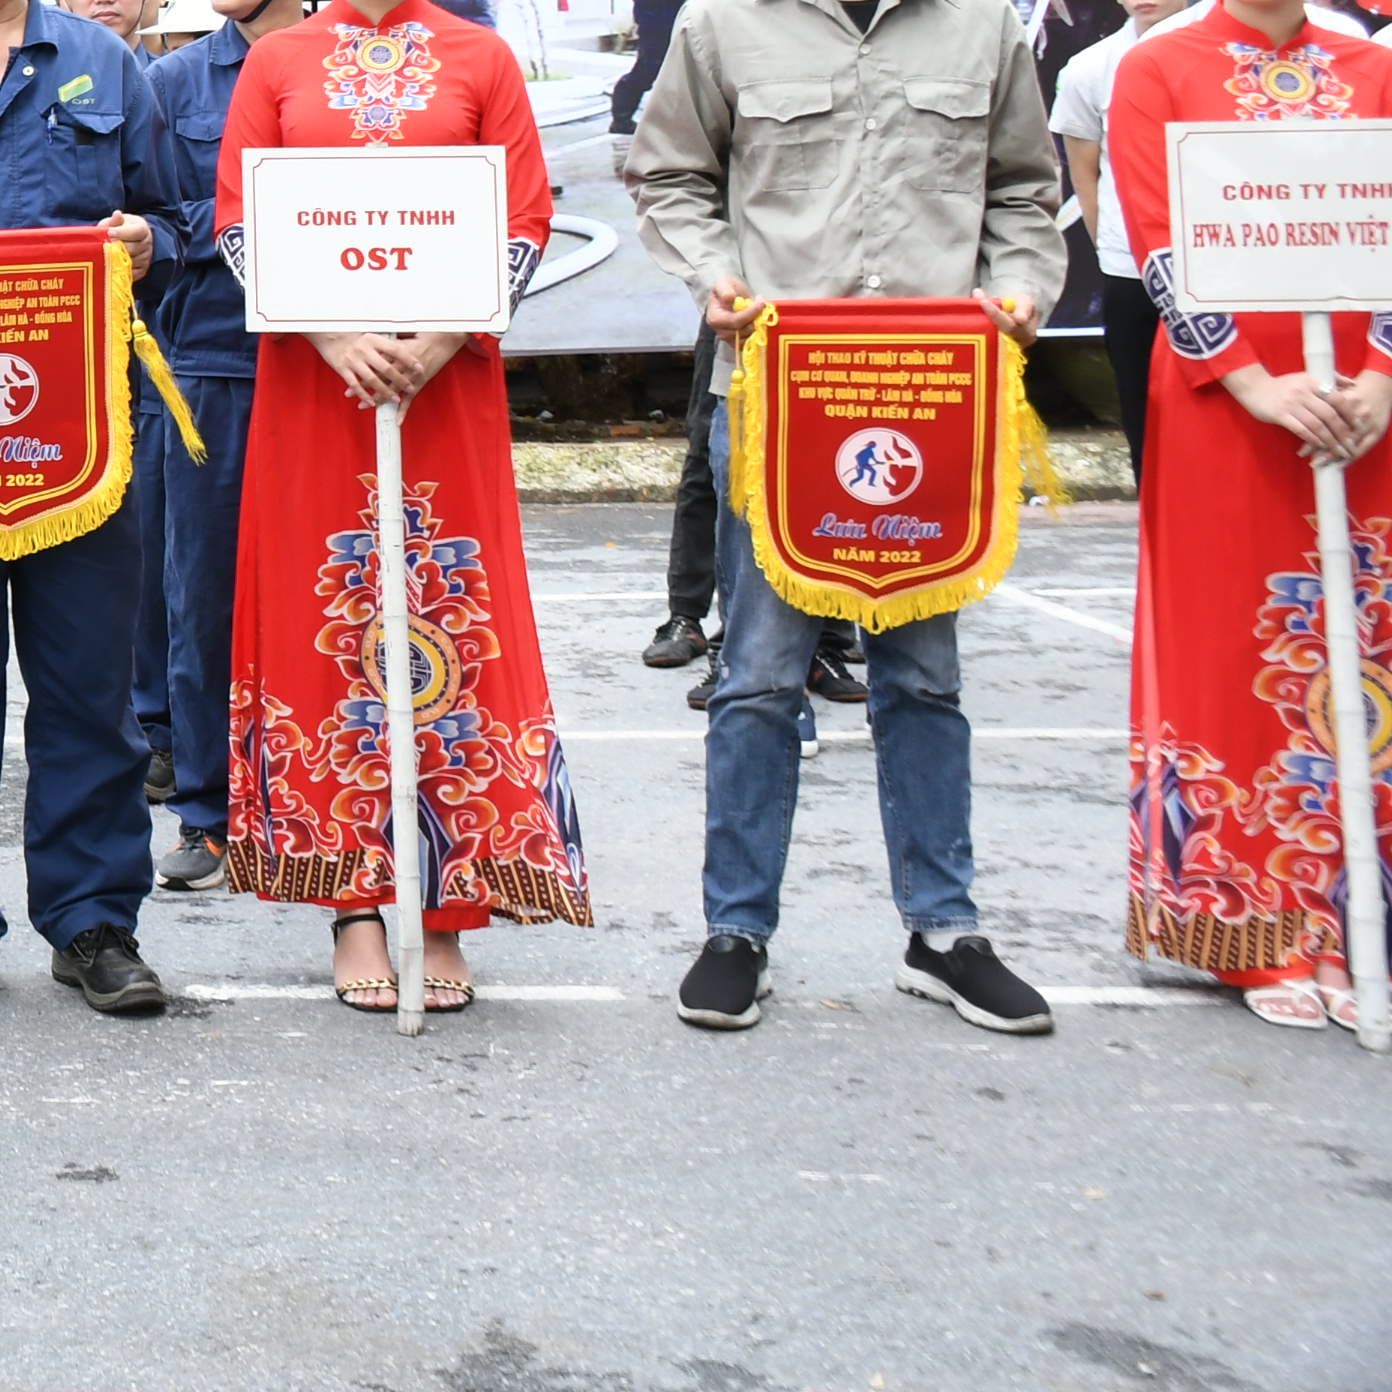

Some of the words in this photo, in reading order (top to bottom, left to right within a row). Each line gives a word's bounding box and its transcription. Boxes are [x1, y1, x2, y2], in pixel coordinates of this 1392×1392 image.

[1222, 181, 1291, 201] CÔNG
[1299, 184, 1327, 199] TY
[297, 208, 357, 226] CÔNG
[365, 211, 389, 226] TY
[397, 211, 455, 226] TNHH
[1193, 224, 1236, 248] HWA
[1242, 223, 1280, 247] PAO
[1285, 222, 1339, 247] RESIN
[1346, 214, 1389, 253] VIỆT
[340, 247, 413, 271] OST
[29, 329, 49, 341] AN
[825, 404, 868, 419] QUẬN
[913, 408, 936, 419] AN
[5, 474, 45, 487] 2022
[833, 546, 875, 562] NĂM
[879, 550, 921, 563] 2022
